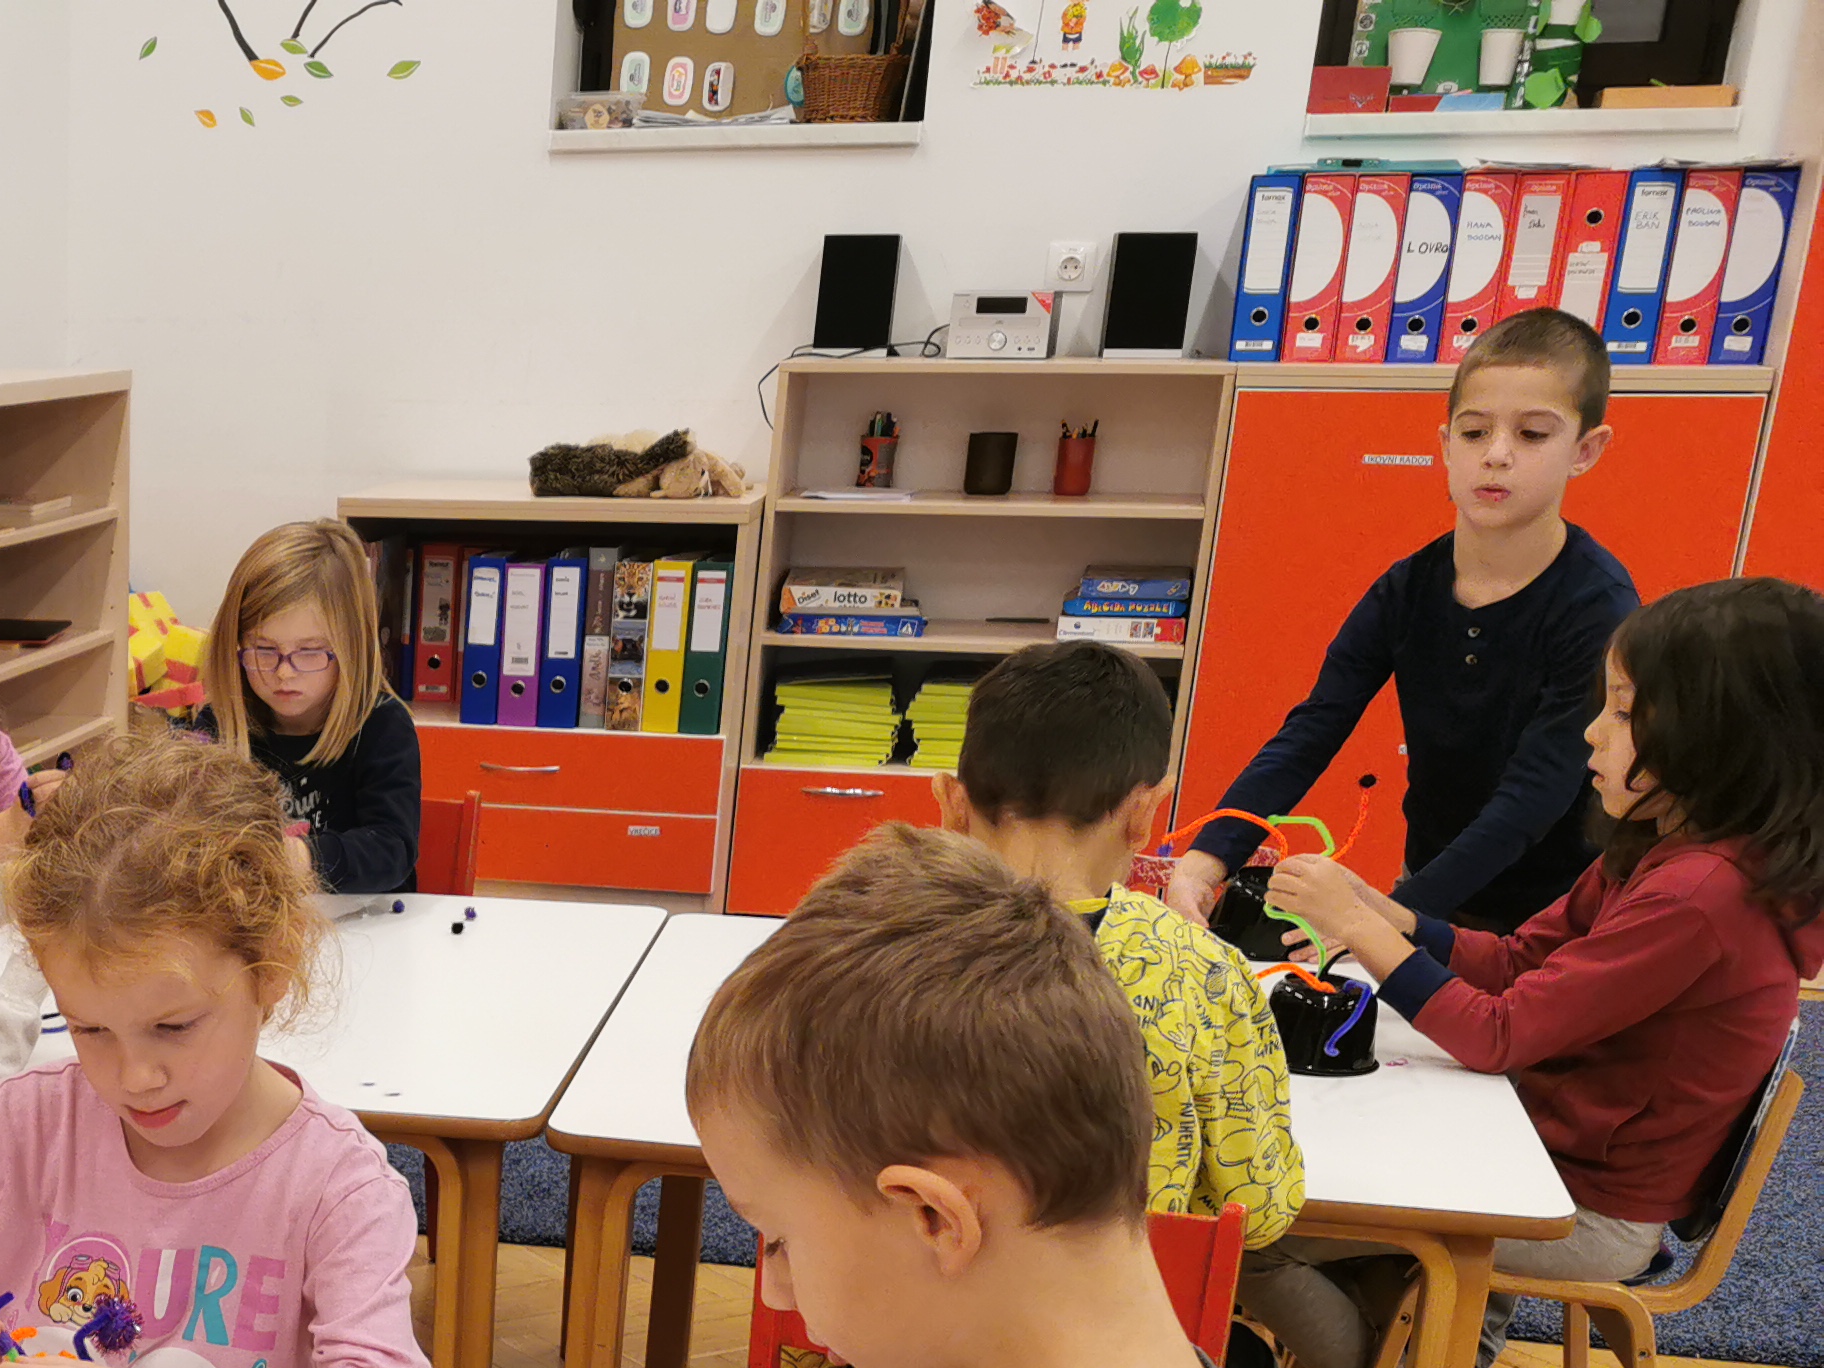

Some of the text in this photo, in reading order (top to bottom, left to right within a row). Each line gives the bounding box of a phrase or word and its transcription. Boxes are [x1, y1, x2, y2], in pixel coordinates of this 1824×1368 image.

[1635, 211, 1659, 221] ERIK
[1635, 221, 1660, 230] BAN
[834, 590, 868, 604] lotto
